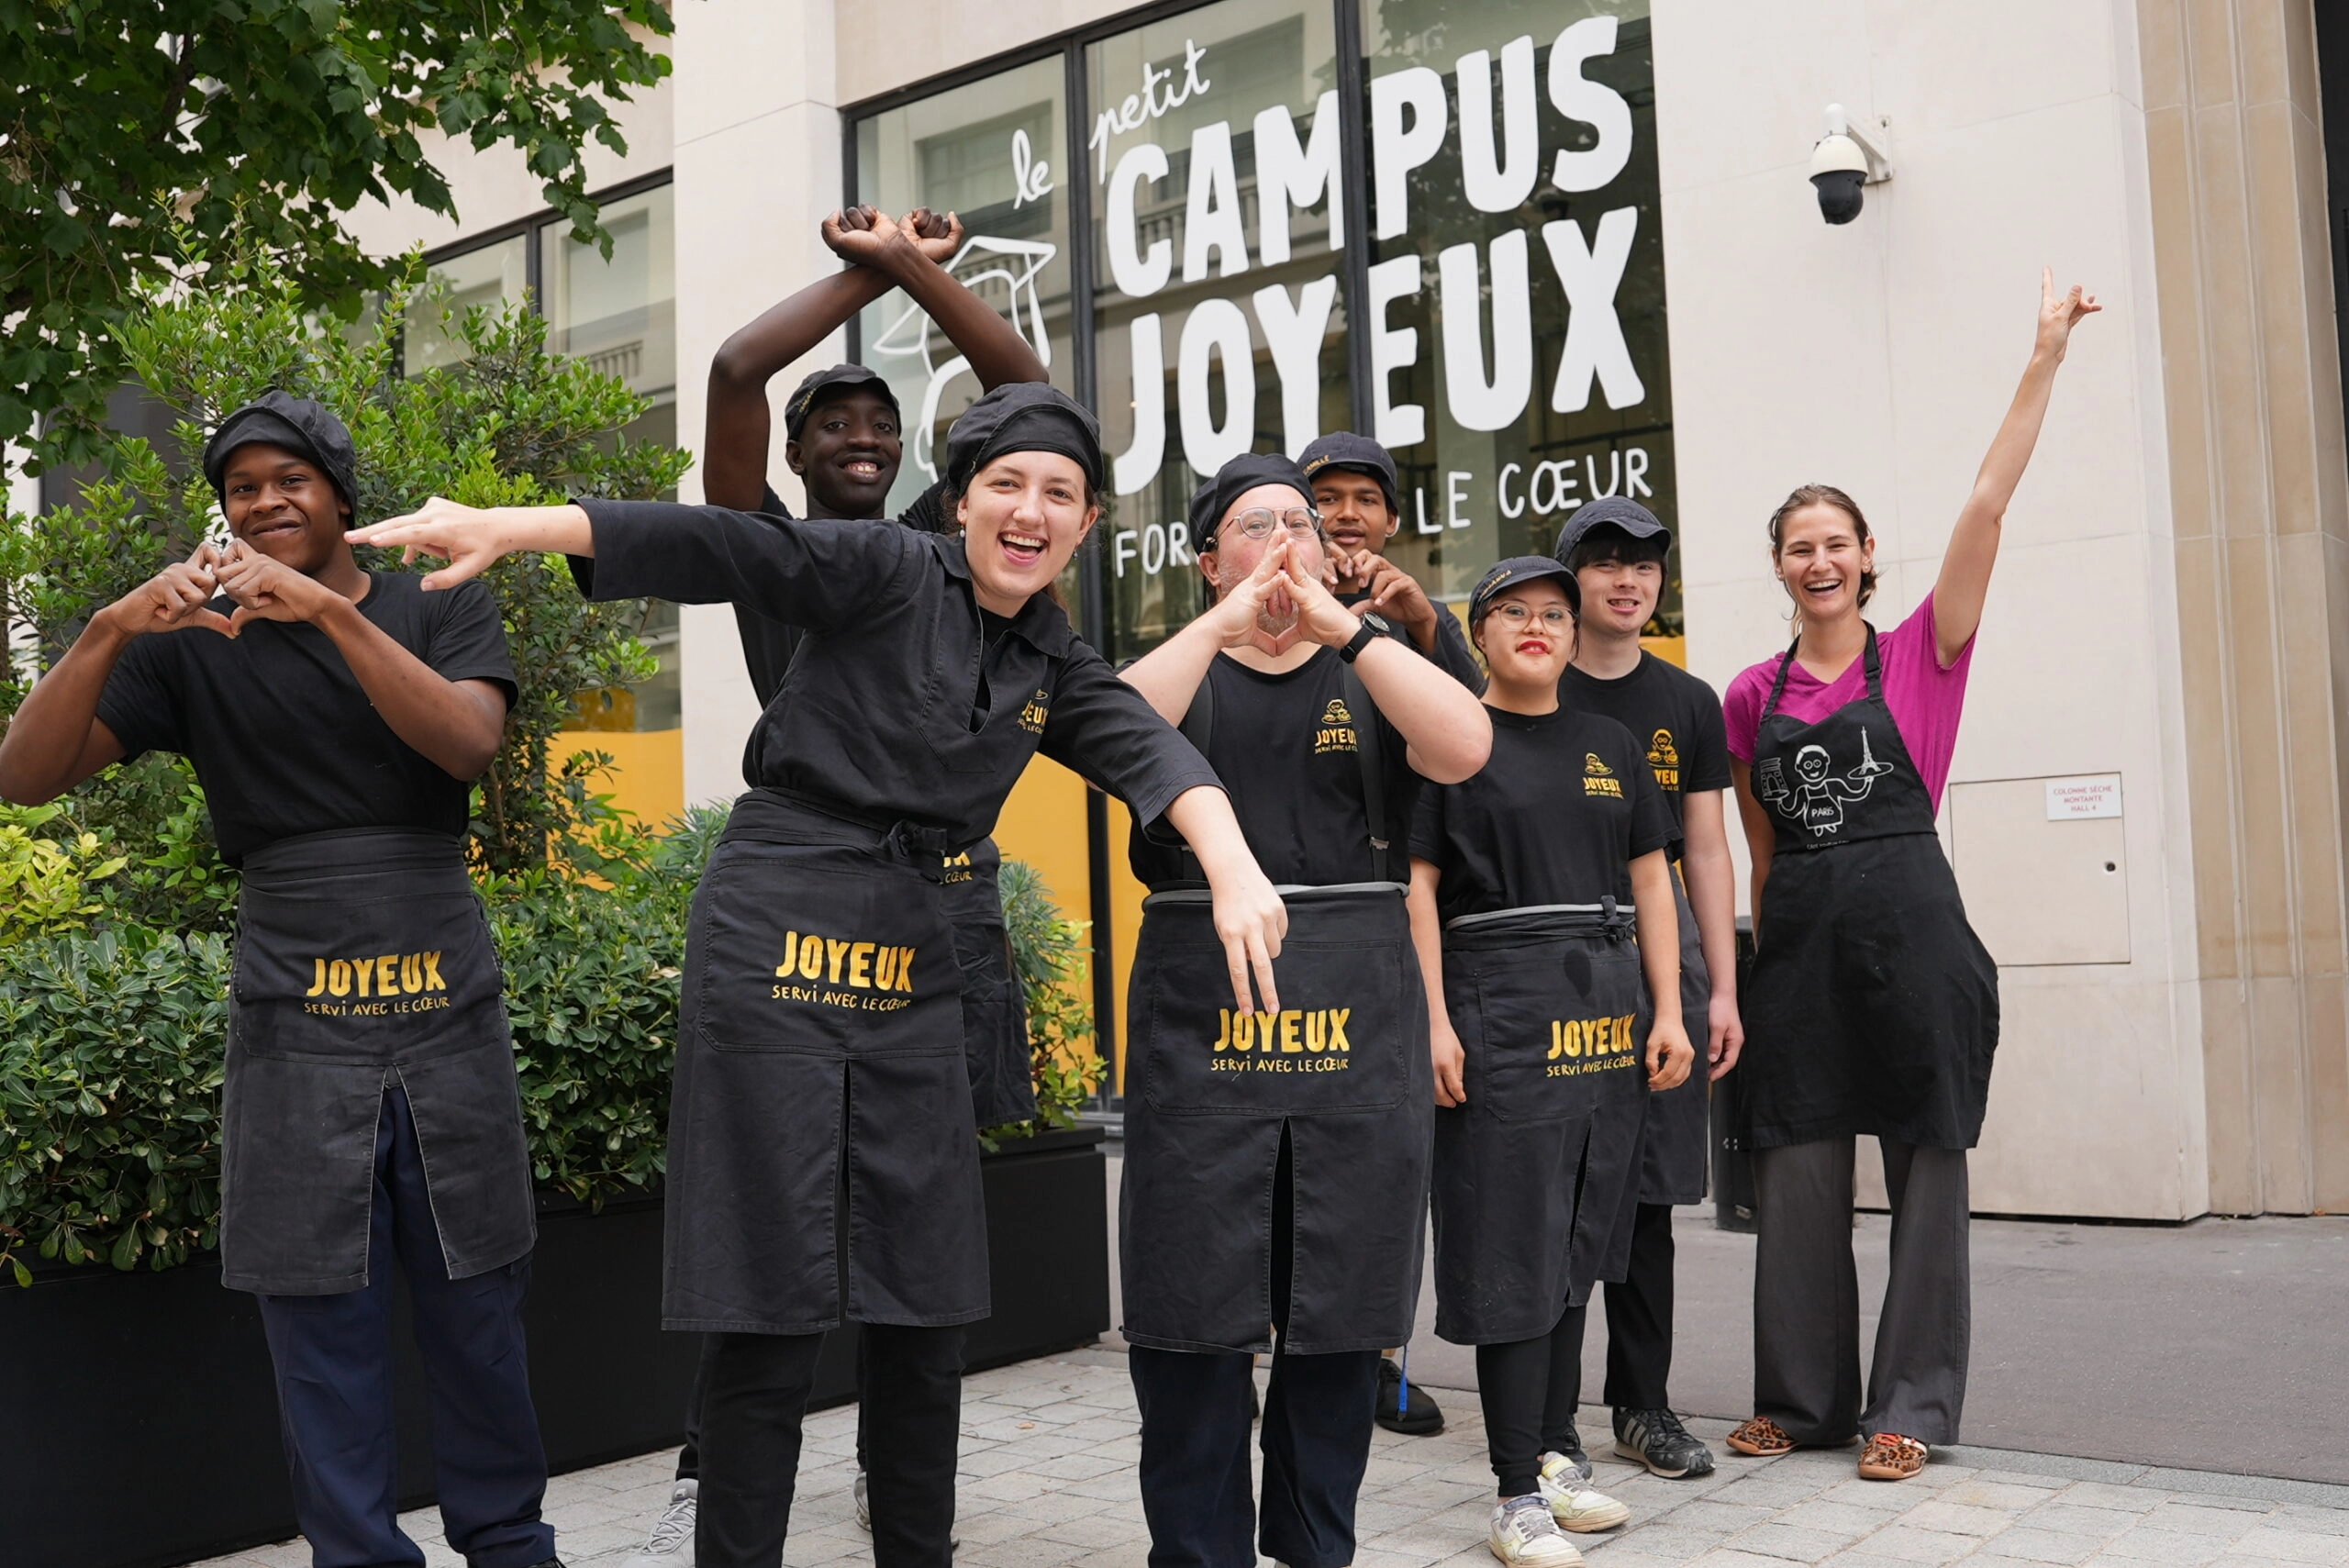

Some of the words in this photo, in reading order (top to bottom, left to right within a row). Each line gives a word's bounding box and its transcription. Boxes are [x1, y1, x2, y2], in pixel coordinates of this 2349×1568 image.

[1011, 128, 1054, 210] le
[1088, 39, 1211, 185] petit
[1106, 15, 1633, 299] CAMPUS
[1112, 206, 1646, 495] JOYEUX
[1115, 521, 1199, 579] FOR
[1416, 470, 1473, 535] LE
[1497, 447, 1653, 519] CŒUR
[1583, 777, 1622, 793] JOYEUX
[1653, 769, 1678, 785] YEU
[2054, 786, 2087, 795] COLONNE
[2064, 795, 2103, 804] MONTANTE
[1811, 806, 1834, 817] PARIS
[945, 871, 973, 884] CŒUR
[774, 930, 917, 993] JOYEUX
[306, 950, 447, 997] JOYEUX
[351, 1003, 388, 1016] AVEC
[394, 1001, 409, 1013] LE
[412, 996, 451, 1012] CŒUR
[822, 990, 858, 1009] AVEC
[862, 996, 880, 1010] LE
[1213, 1007, 1351, 1053] JOYEUX
[1547, 1012, 1636, 1060] JOYEUX
[1255, 1058, 1293, 1073] AVEC
[1297, 1059, 1313, 1073] LE
[1315, 1056, 1349, 1072] CŒUR
[1582, 1060, 1602, 1073] AVEC
[1603, 1058, 1614, 1070] LE
[1613, 1055, 1636, 1069] CŒUR
